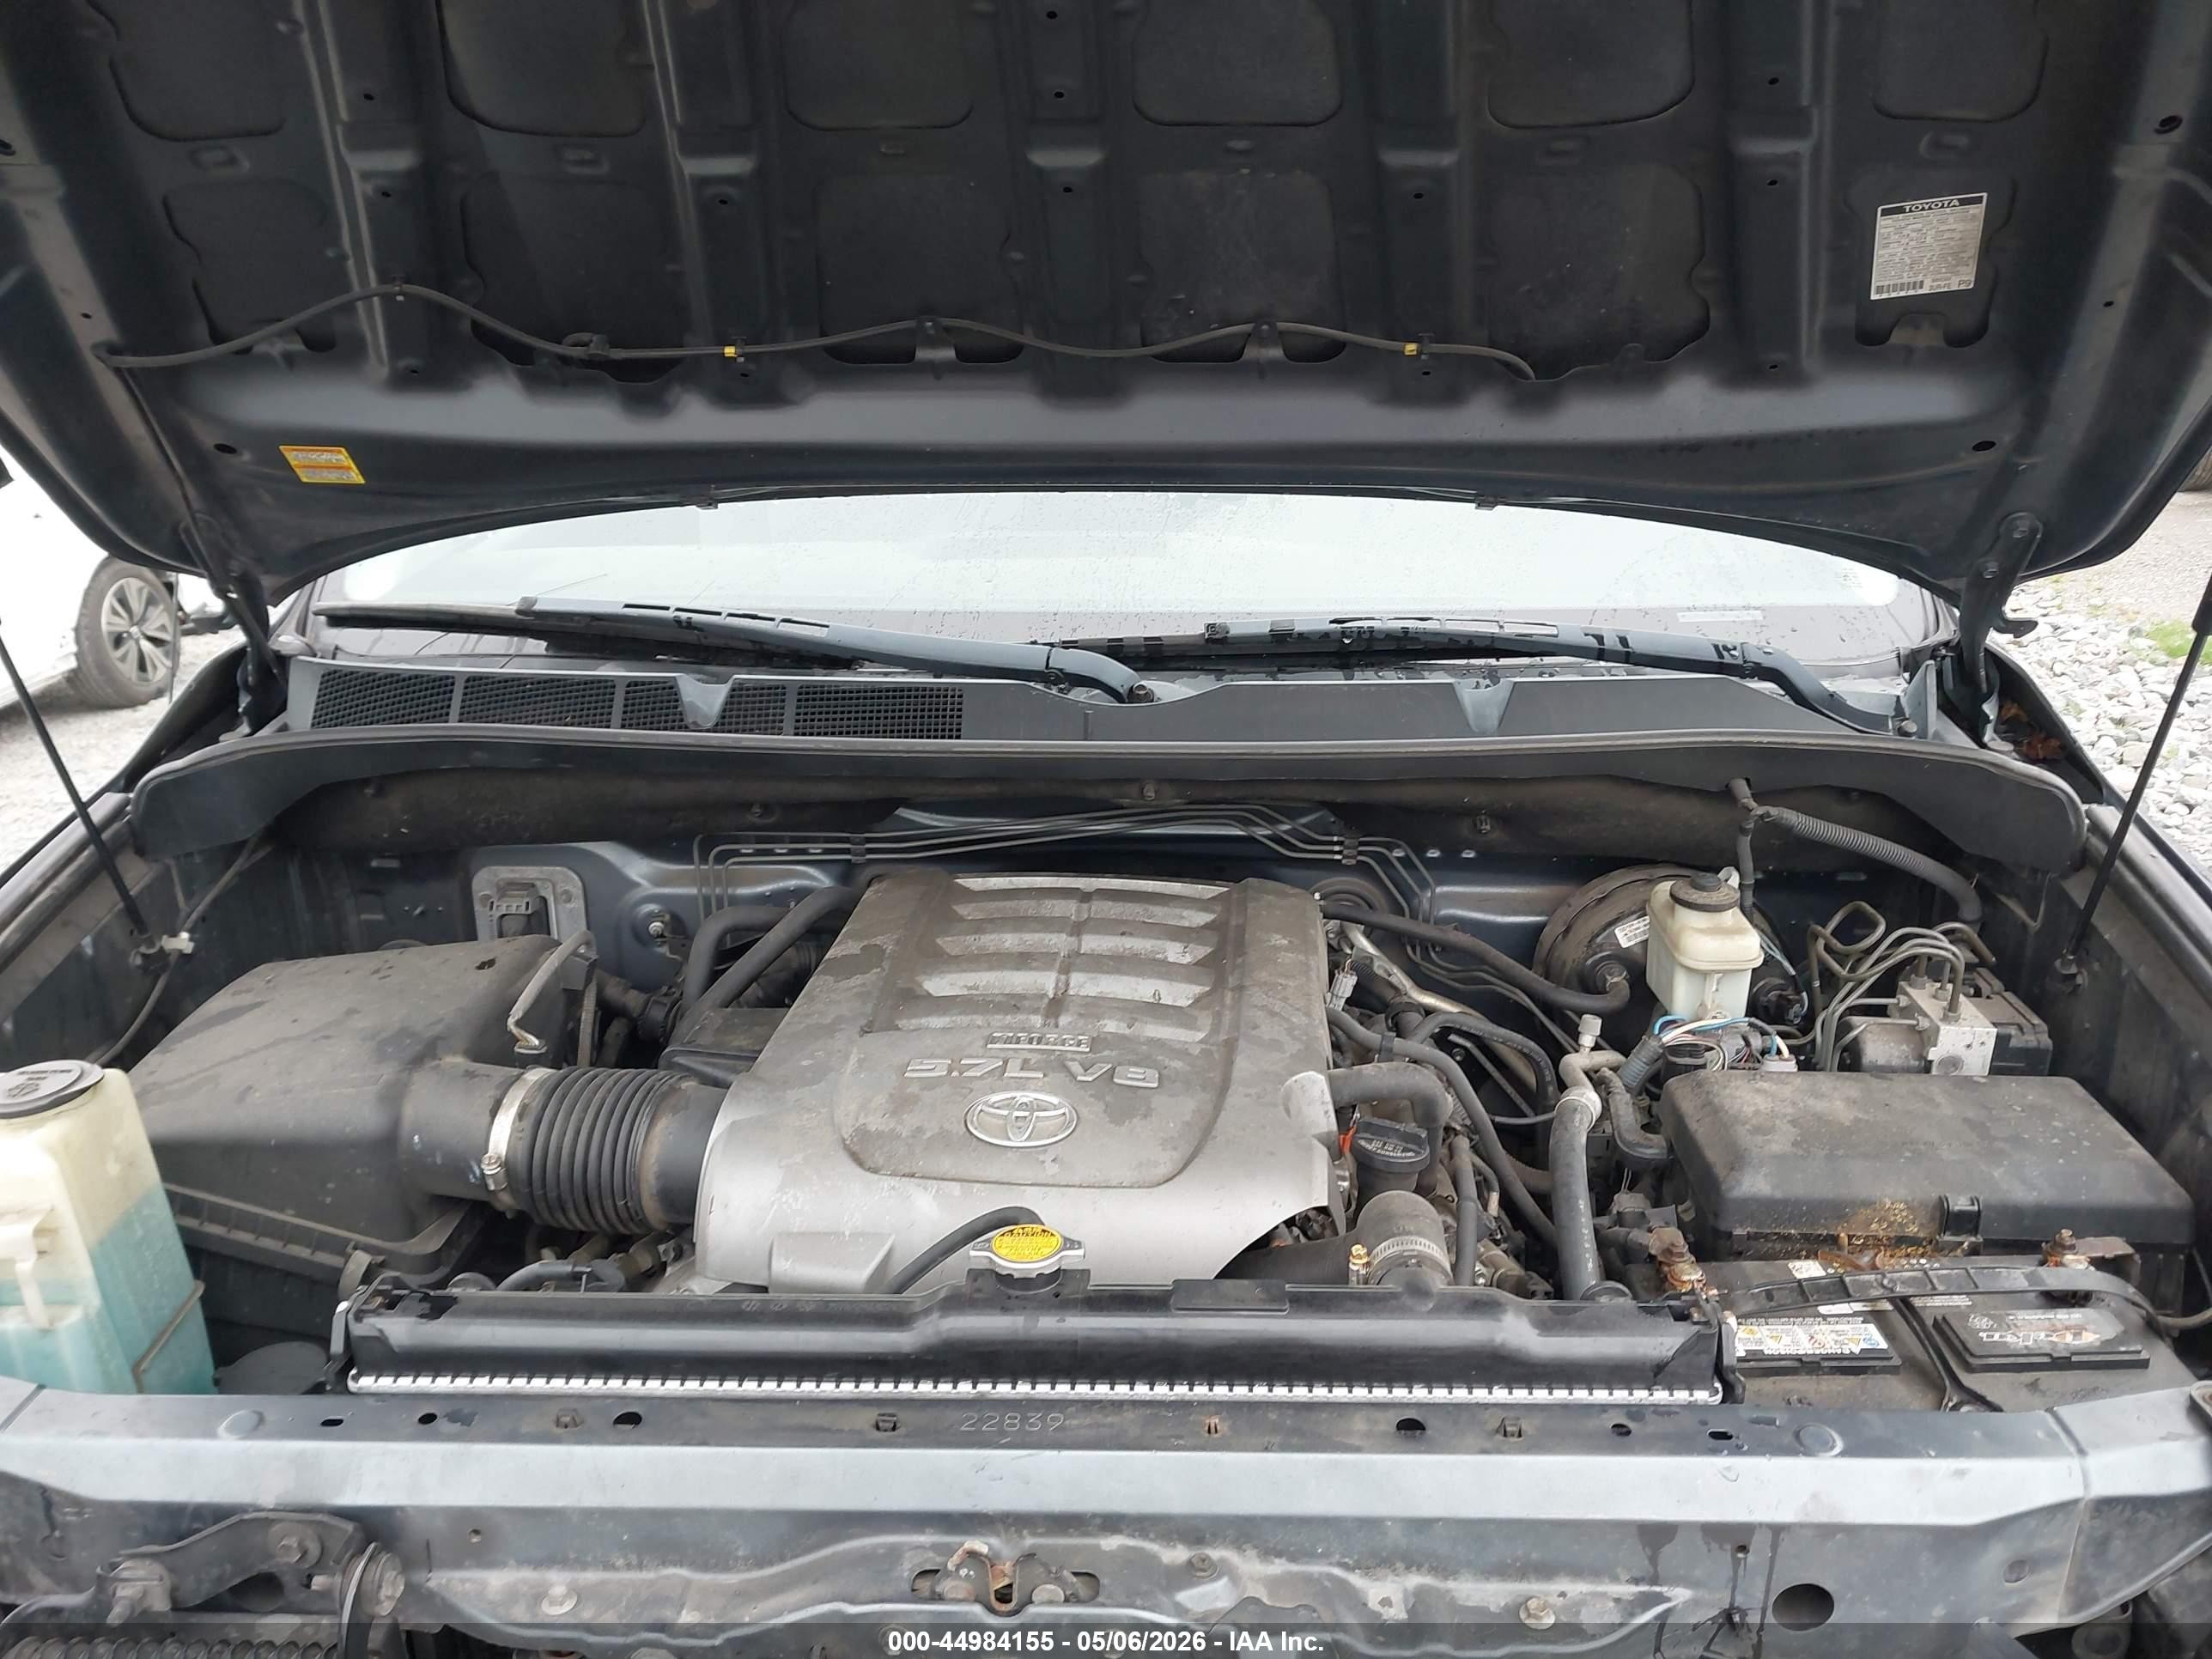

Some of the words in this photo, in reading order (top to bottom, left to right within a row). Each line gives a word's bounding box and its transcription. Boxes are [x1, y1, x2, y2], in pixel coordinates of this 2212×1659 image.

[1903, 198, 1960, 213] TOYOTA
[903, 1058, 1045, 1079] 5.7L
[1064, 1060, 1159, 1088] V8
[959, 1412, 1065, 1431] 22839
